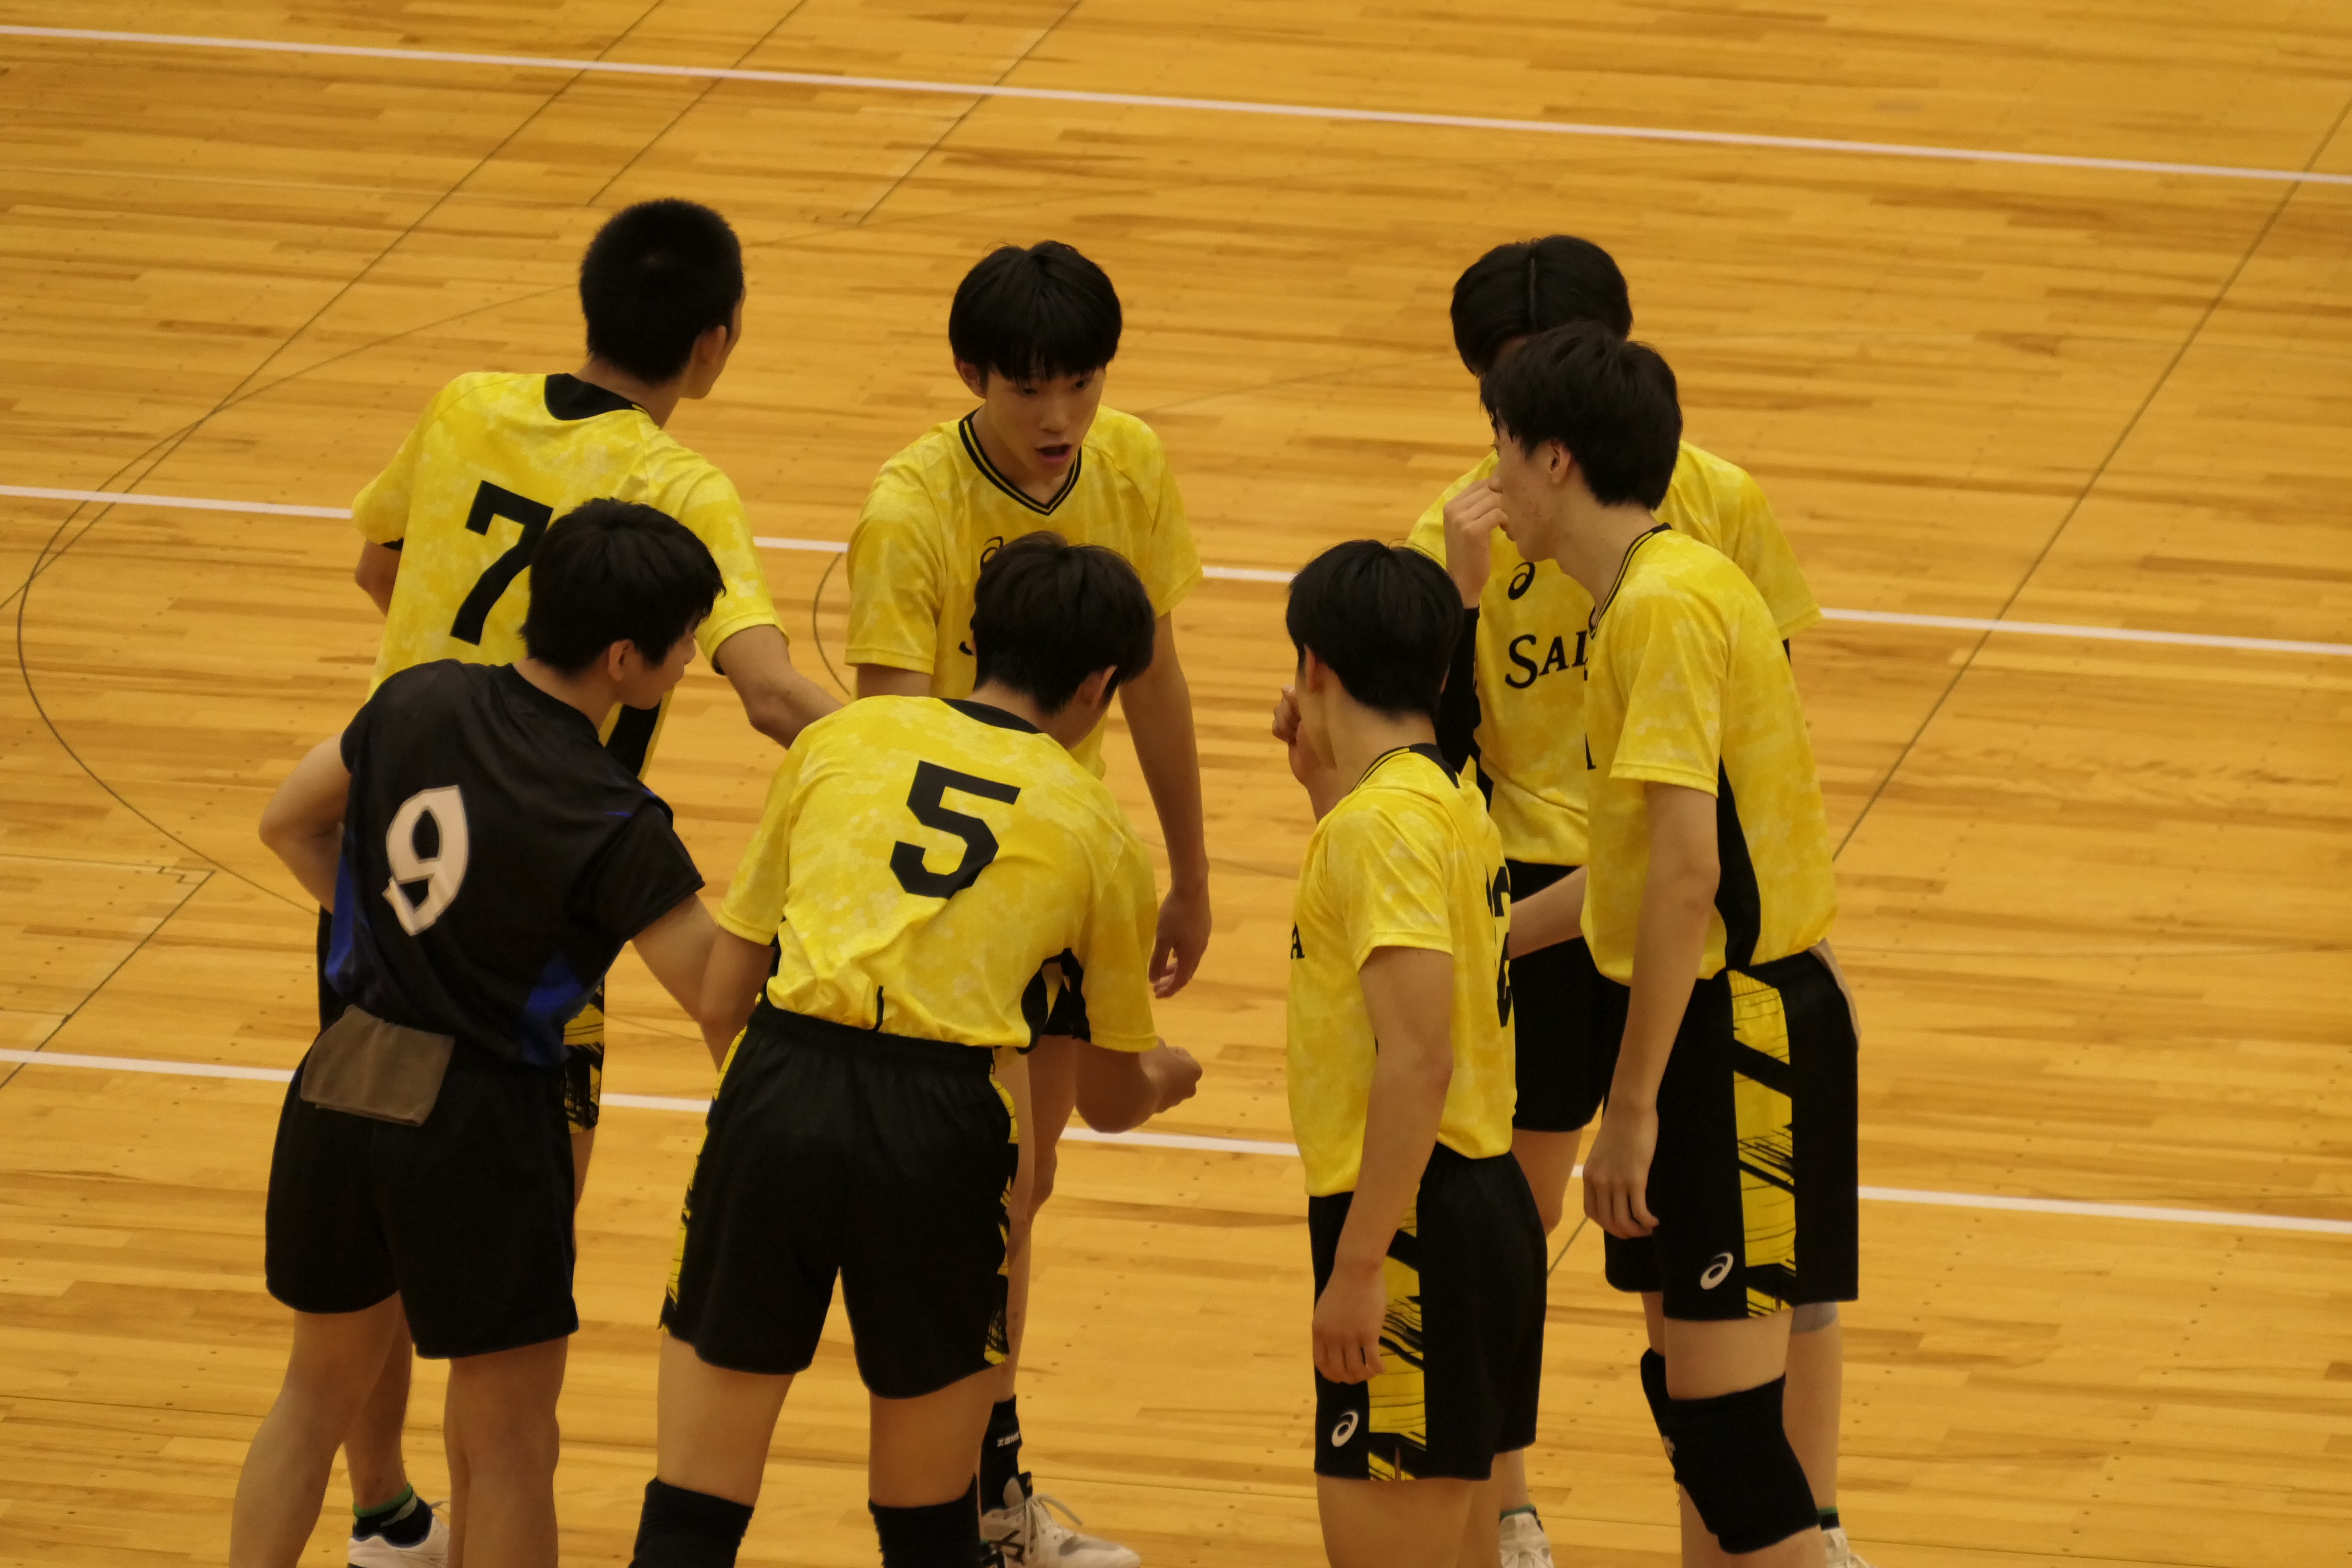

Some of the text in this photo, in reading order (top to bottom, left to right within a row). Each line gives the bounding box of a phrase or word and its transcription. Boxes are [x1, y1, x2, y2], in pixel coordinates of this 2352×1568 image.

[450, 479, 554, 646] 7
[382, 784, 469, 937] 9
[889, 760, 1021, 900] 5
